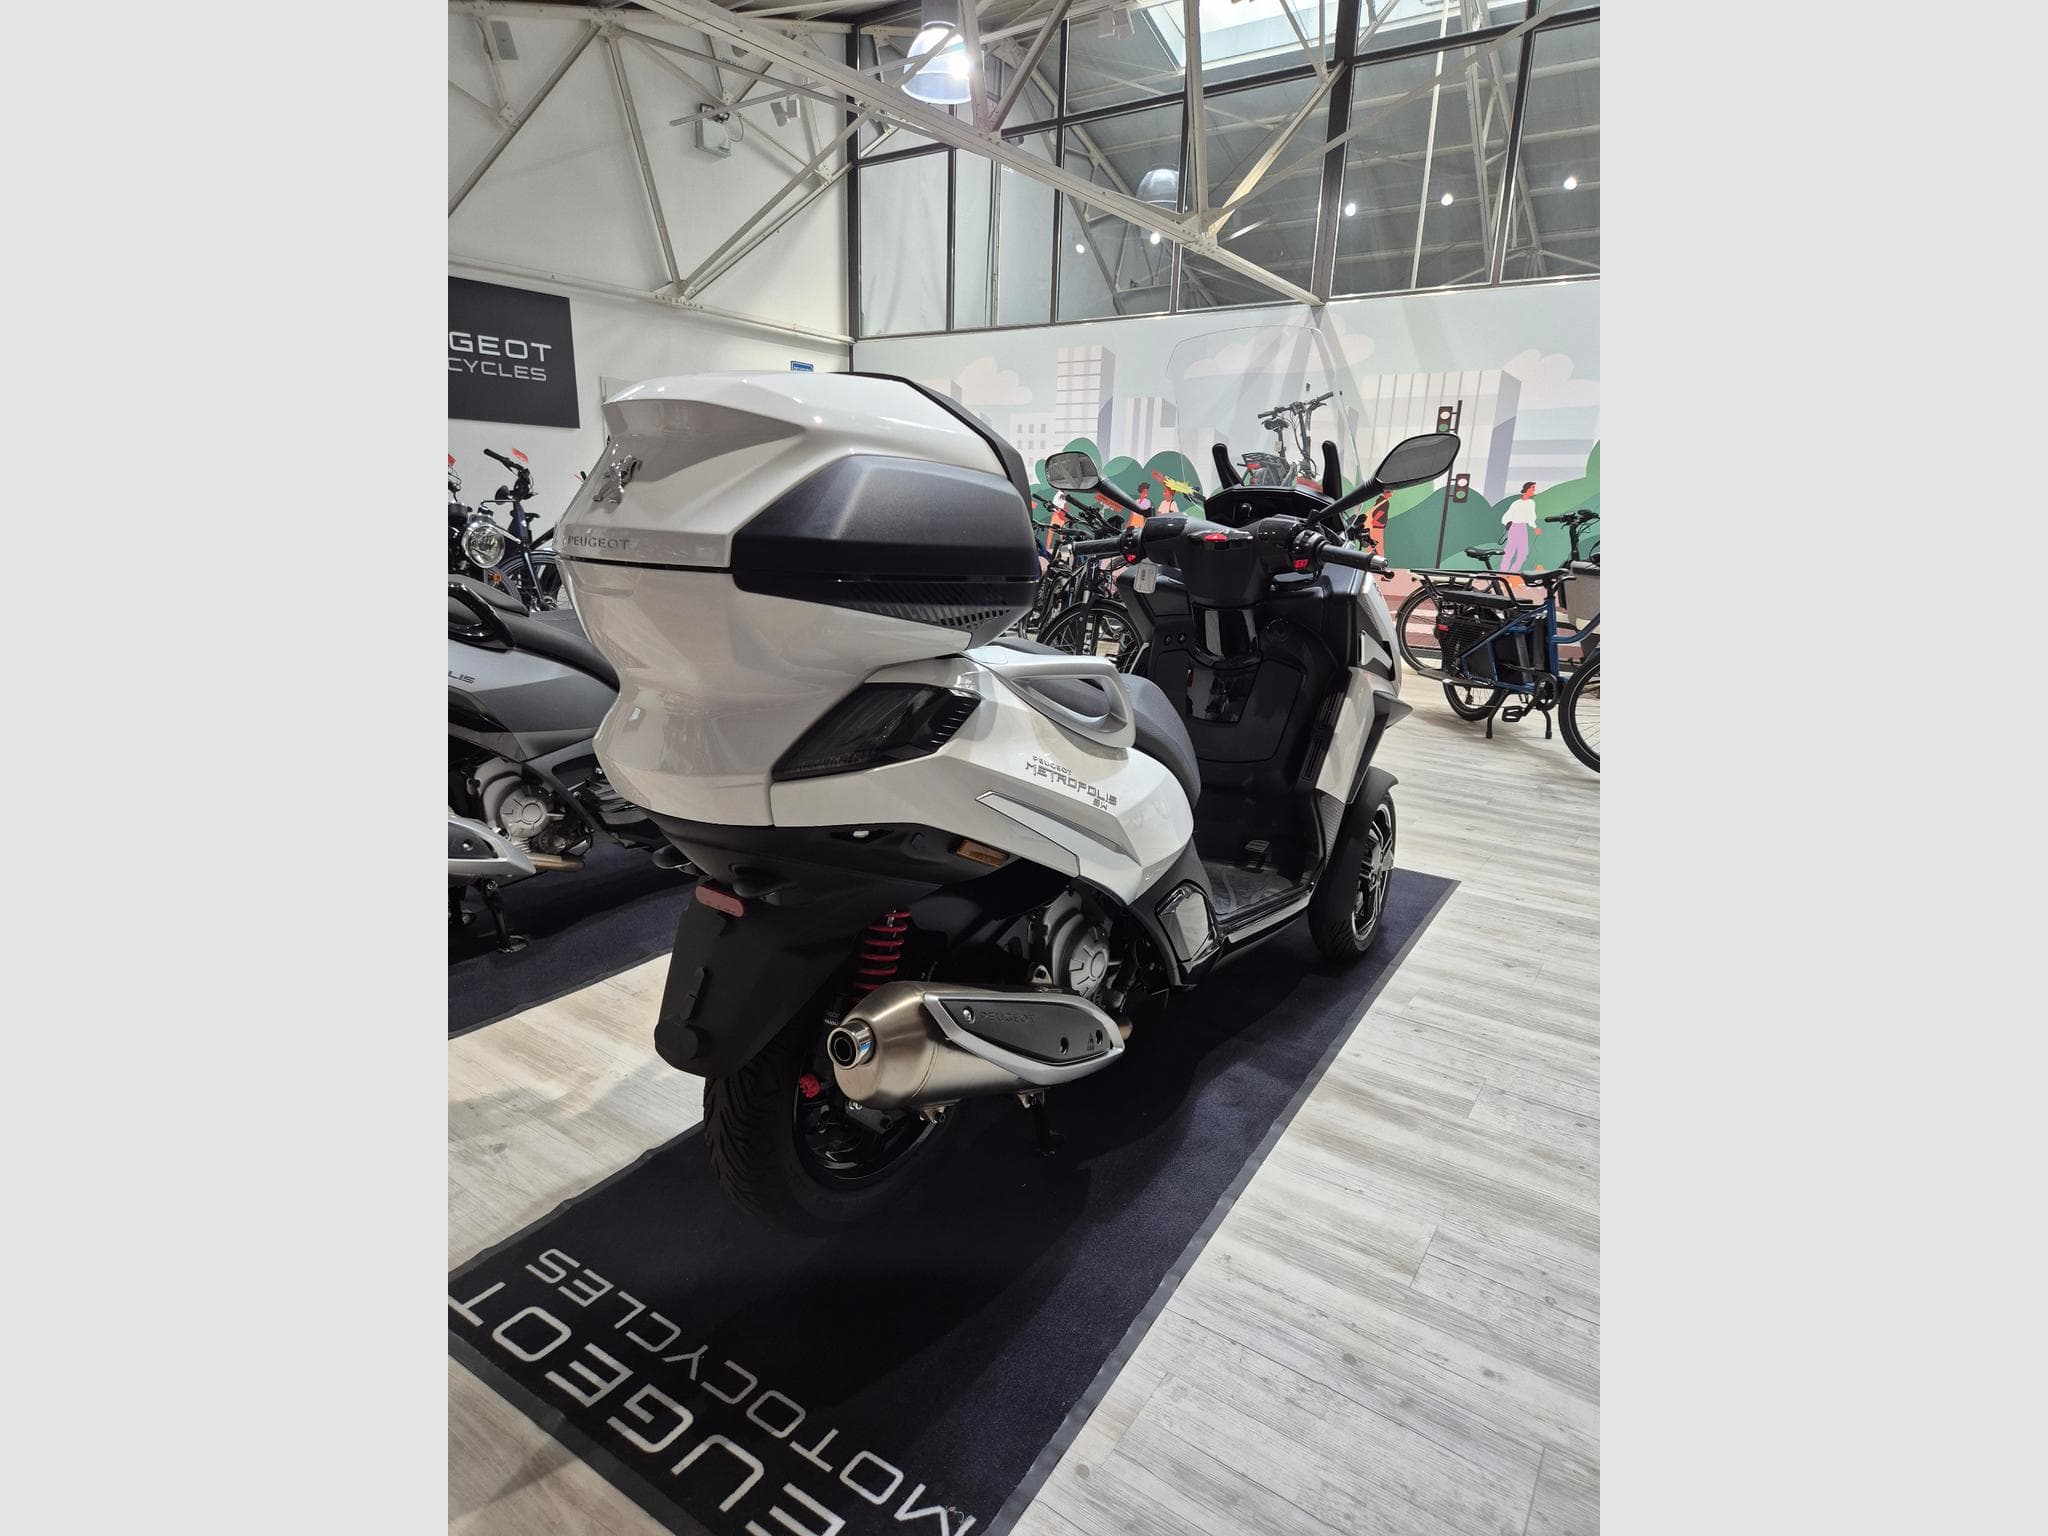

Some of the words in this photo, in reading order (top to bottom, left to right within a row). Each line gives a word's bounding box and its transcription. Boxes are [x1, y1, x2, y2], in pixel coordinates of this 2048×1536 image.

[449, 331, 552, 362] GEOT
[448, 357, 547, 382] CYCLES
[567, 535, 630, 550] PEUGEOT
[1032, 755, 1073, 776] PEUGEOT
[1025, 761, 1117, 806] METROPOLIS
[524, 1248, 977, 1536] MOTOCYCLES
